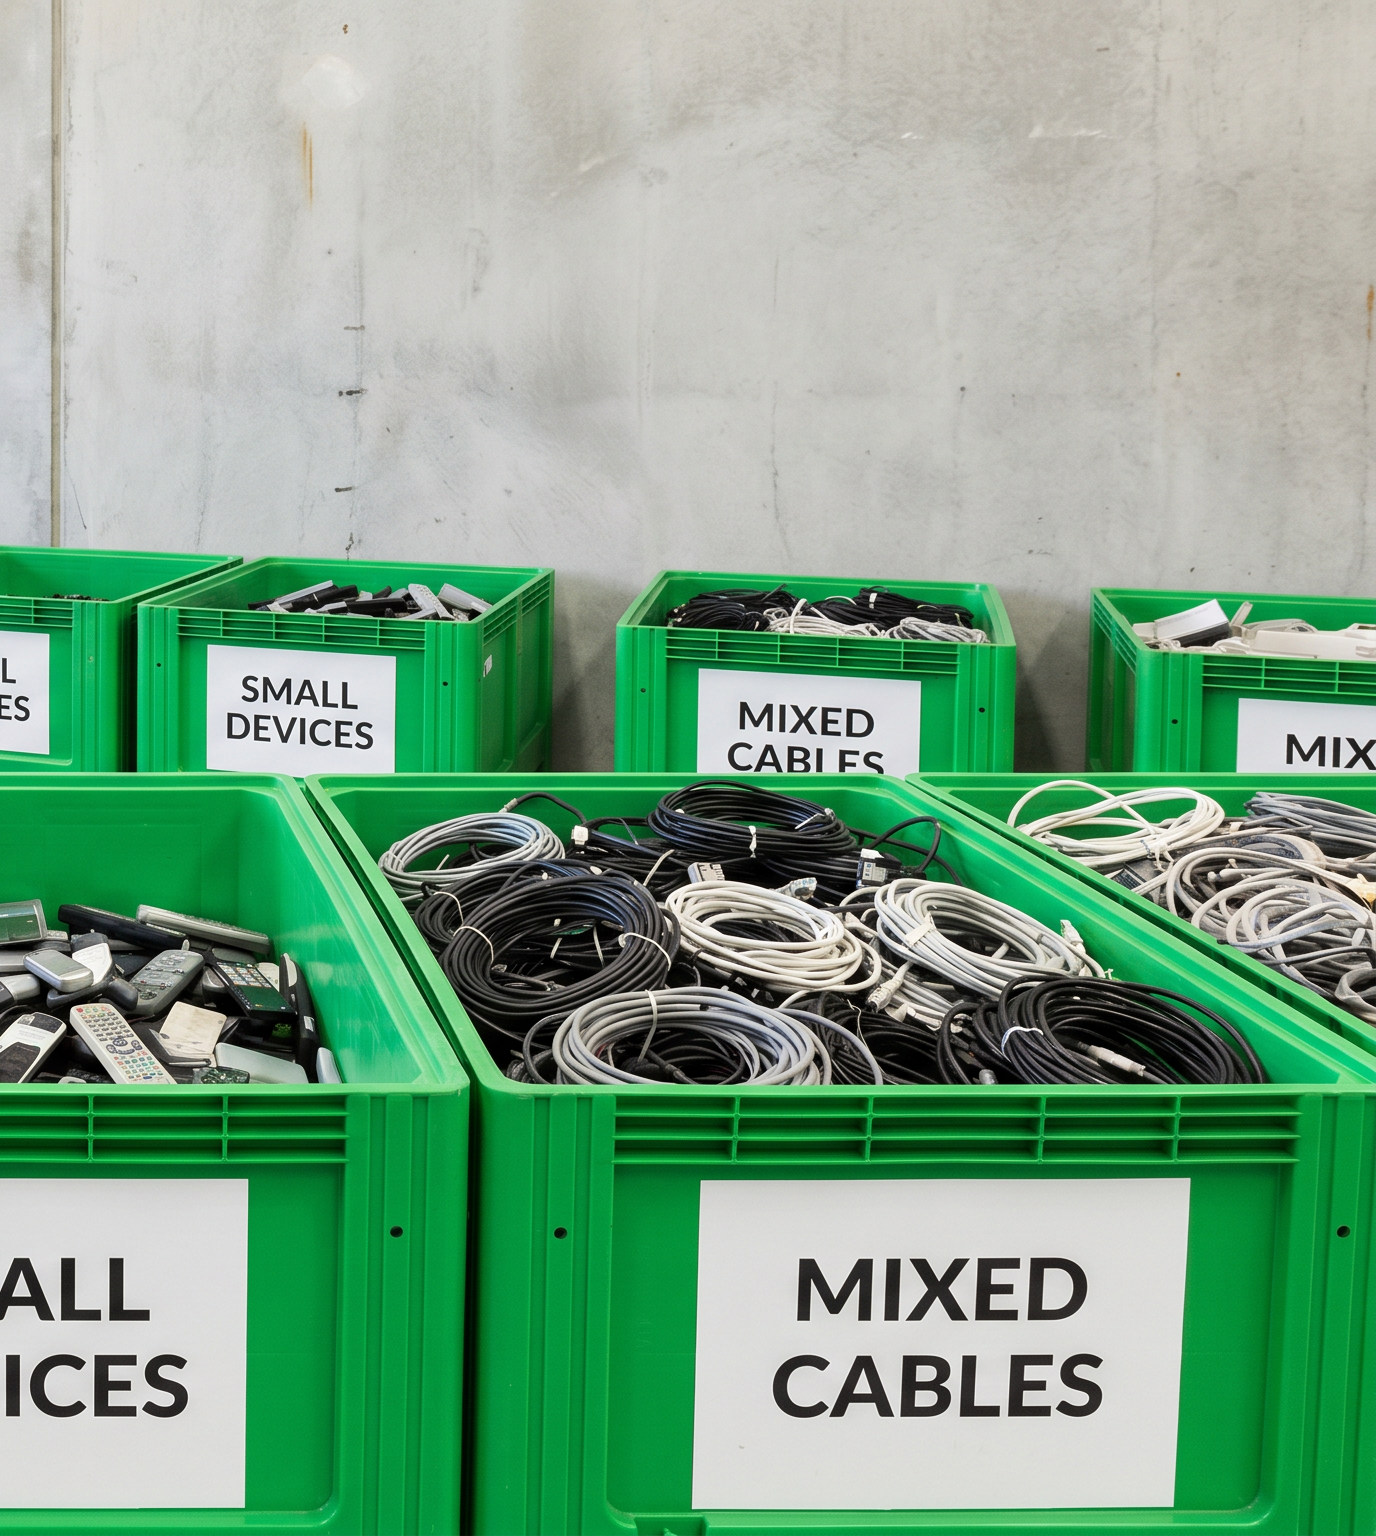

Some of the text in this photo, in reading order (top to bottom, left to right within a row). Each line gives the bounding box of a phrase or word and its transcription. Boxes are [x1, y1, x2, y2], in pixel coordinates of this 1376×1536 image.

[241, 675, 358, 710] SMALL
[226, 712, 374, 750] DEVICES
[739, 701, 875, 738] MIXED
[1286, 733, 1376, 771] MIX
[796, 1257, 1088, 1322] MIXED
[772, 1353, 1104, 1419] CABLES
